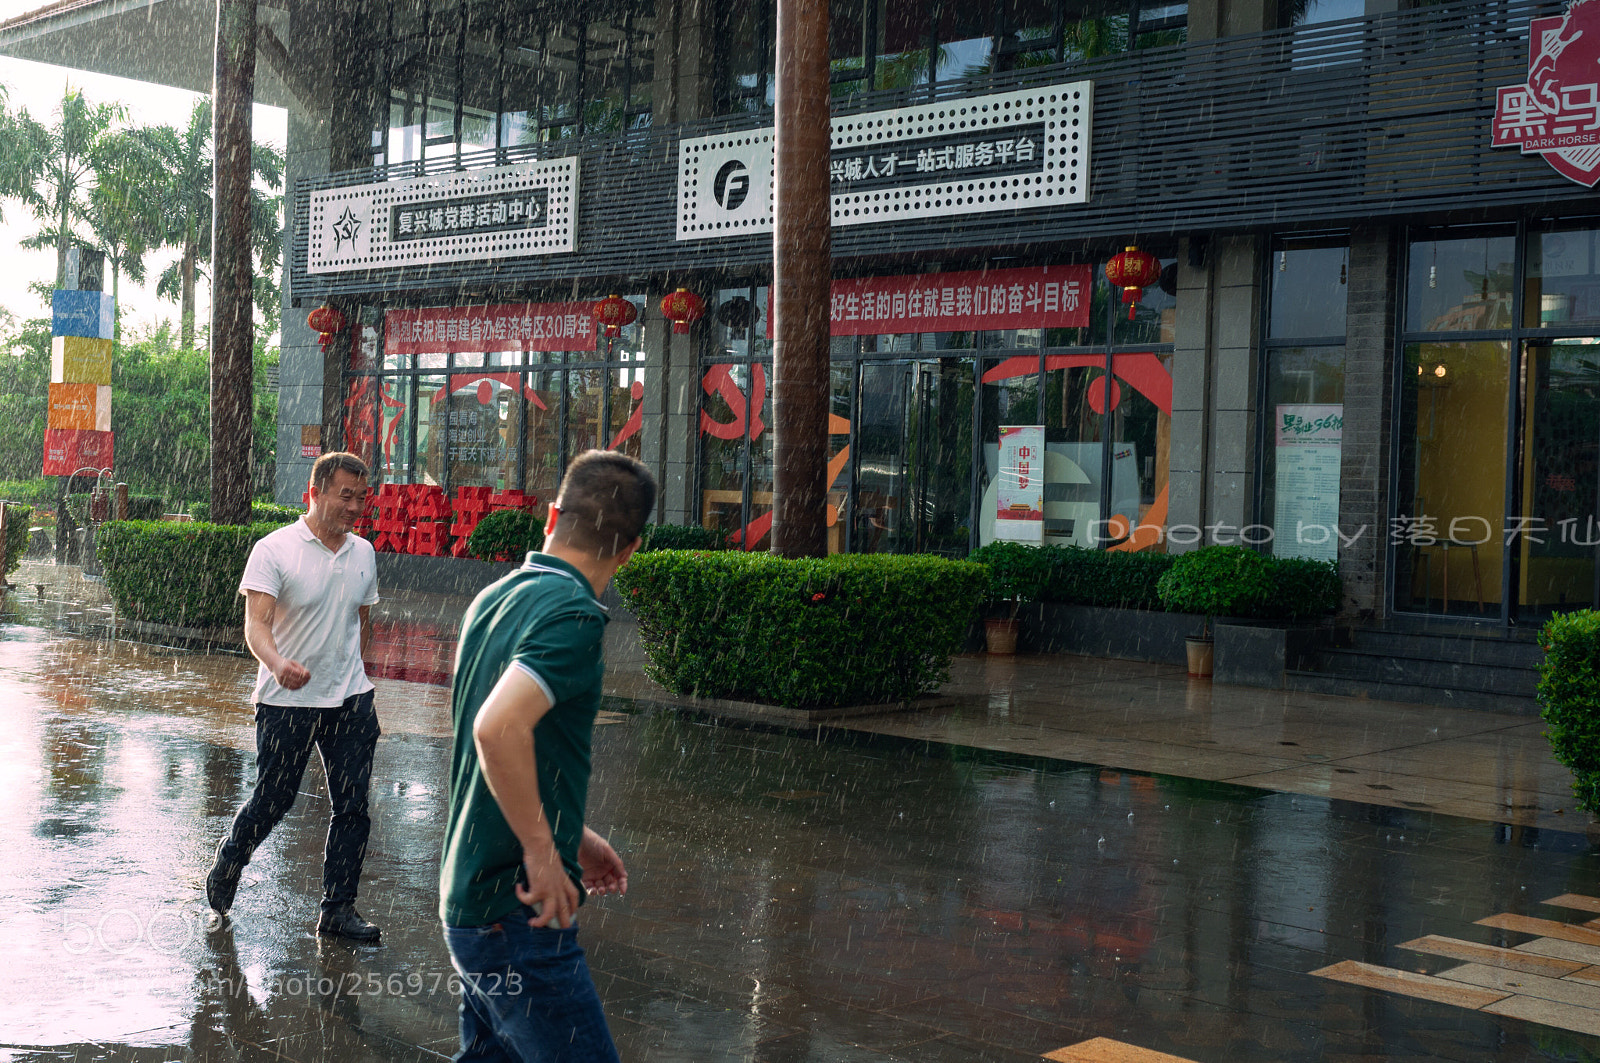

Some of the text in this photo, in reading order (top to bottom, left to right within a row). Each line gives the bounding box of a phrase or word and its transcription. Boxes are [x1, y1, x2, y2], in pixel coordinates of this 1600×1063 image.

[830, 137, 1036, 182] 兴城人才一站式服务平台
[1525, 133, 1597, 149] DARK HORSE
[399, 196, 541, 234] 复兴城党群活动中心
[831, 280, 1080, 322] 好生活的向往就是我们的奋斗目标
[391, 314, 591, 343] 热烈庆祝海南建省办经济特区30周年
